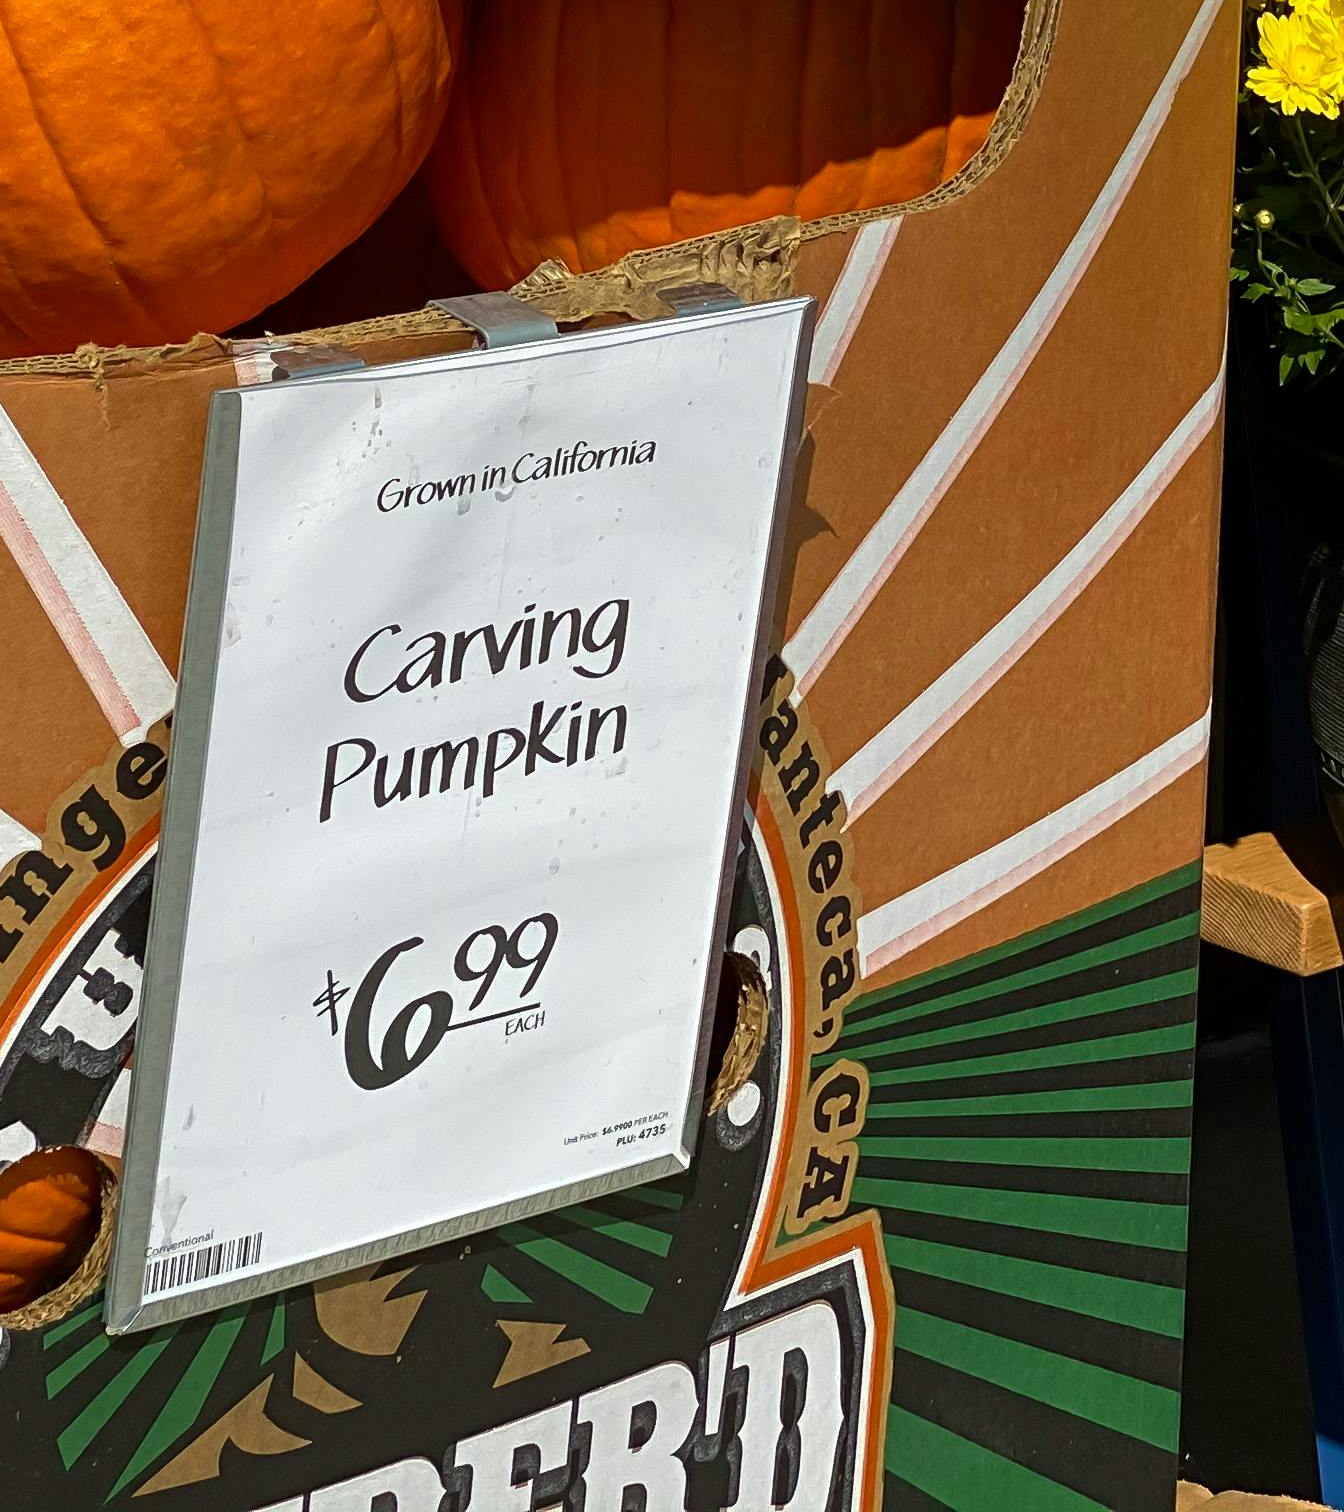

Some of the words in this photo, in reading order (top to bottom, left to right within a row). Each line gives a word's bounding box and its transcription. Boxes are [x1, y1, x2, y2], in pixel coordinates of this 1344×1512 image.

[377, 473, 475, 513] Grown
[481, 464, 506, 491] in
[511, 440, 656, 484] California
[344, 598, 630, 703] Carving
[319, 700, 627, 823] Pumpkin
[505, 1010, 545, 1035] EACH
[616, 1135, 637, 1147] PLU:
[638, 1123, 666, 1139] 4735
[633, 1116, 647, 1126] PER
[648, 1110, 668, 1123] EACH
[797, 1073, 859, 1219] CA
[144, 1229, 214, 1258] Conventional
